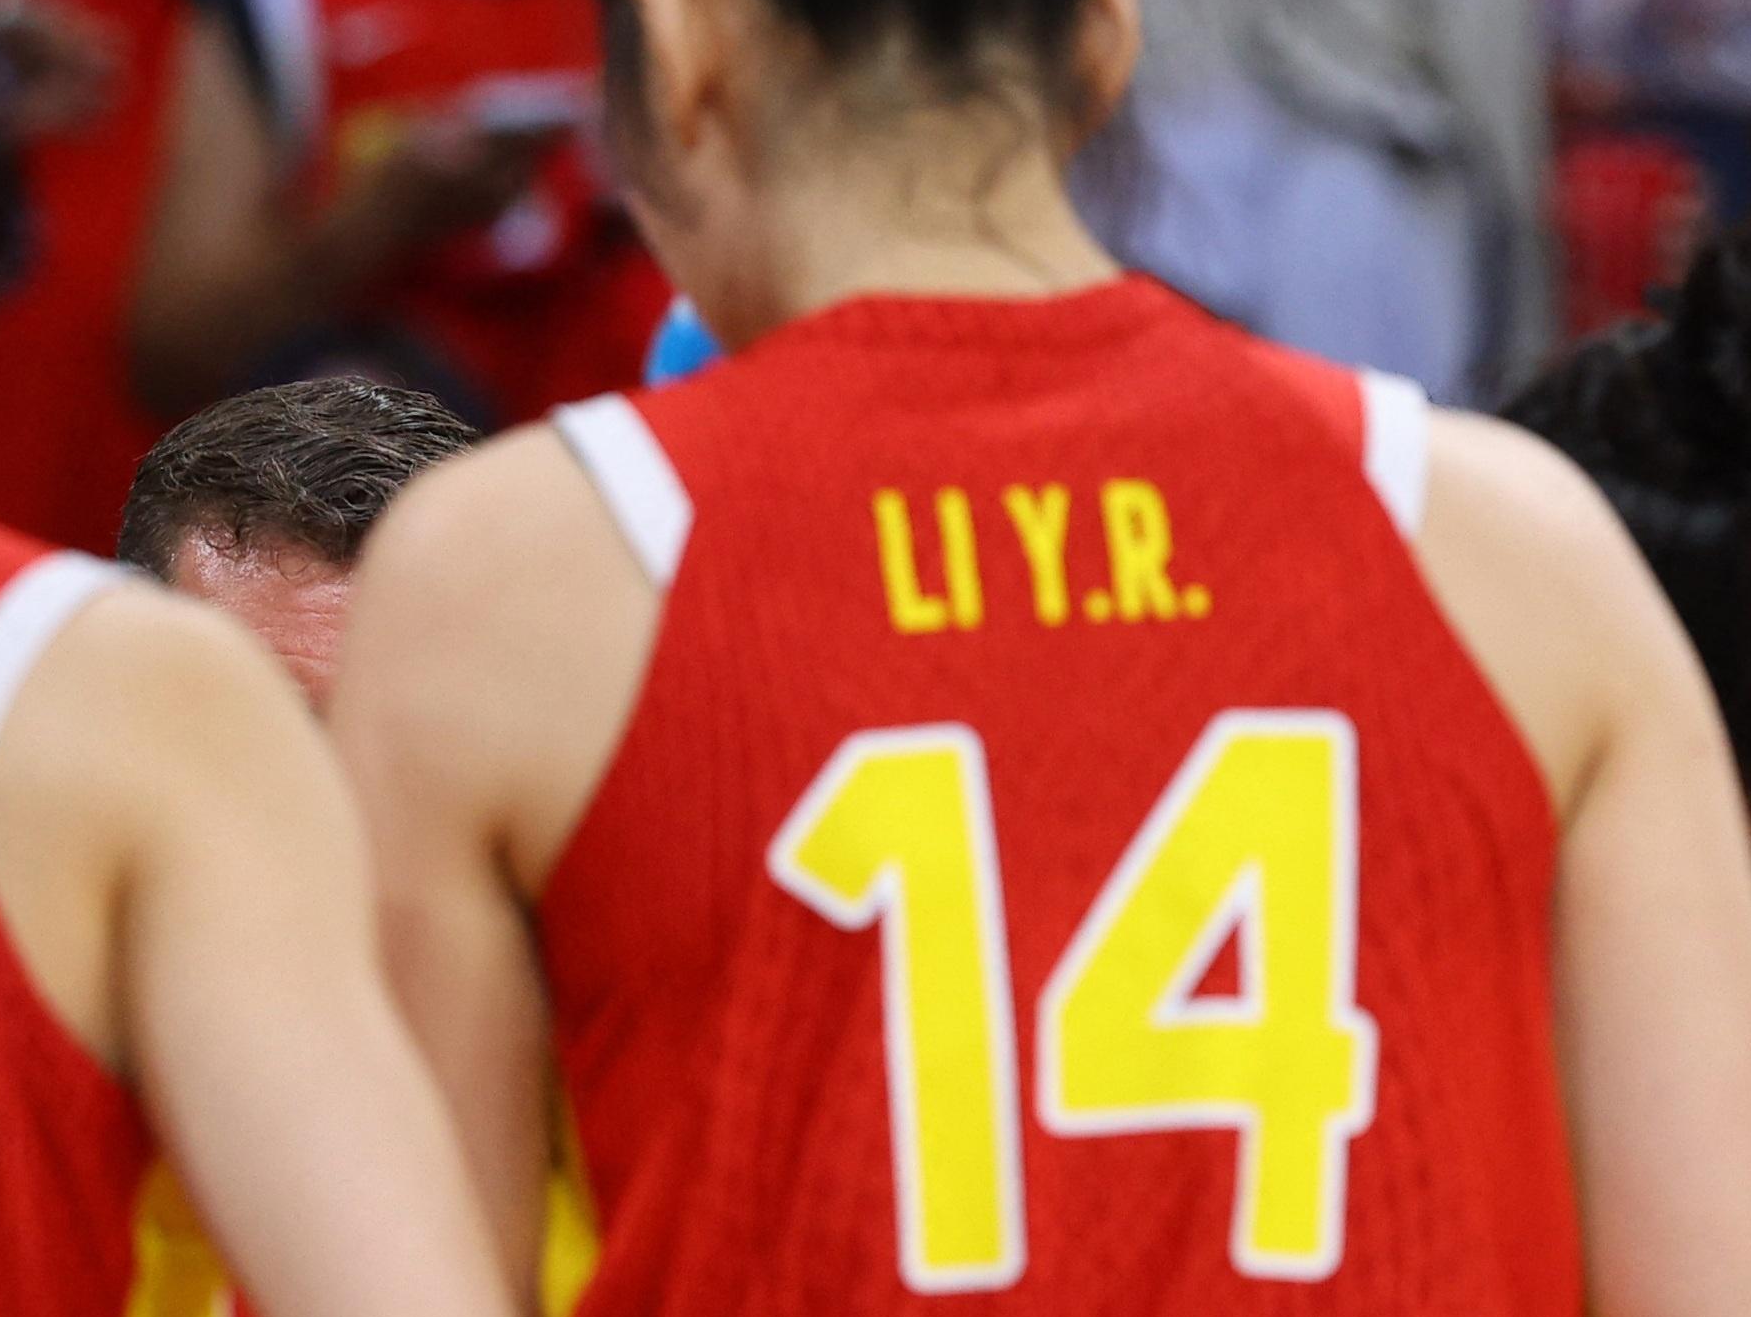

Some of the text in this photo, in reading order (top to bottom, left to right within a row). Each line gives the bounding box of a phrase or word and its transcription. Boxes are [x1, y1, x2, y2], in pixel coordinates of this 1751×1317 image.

[873, 478, 1212, 634] LI Y.R.
[765, 707, 1380, 1296] 14
